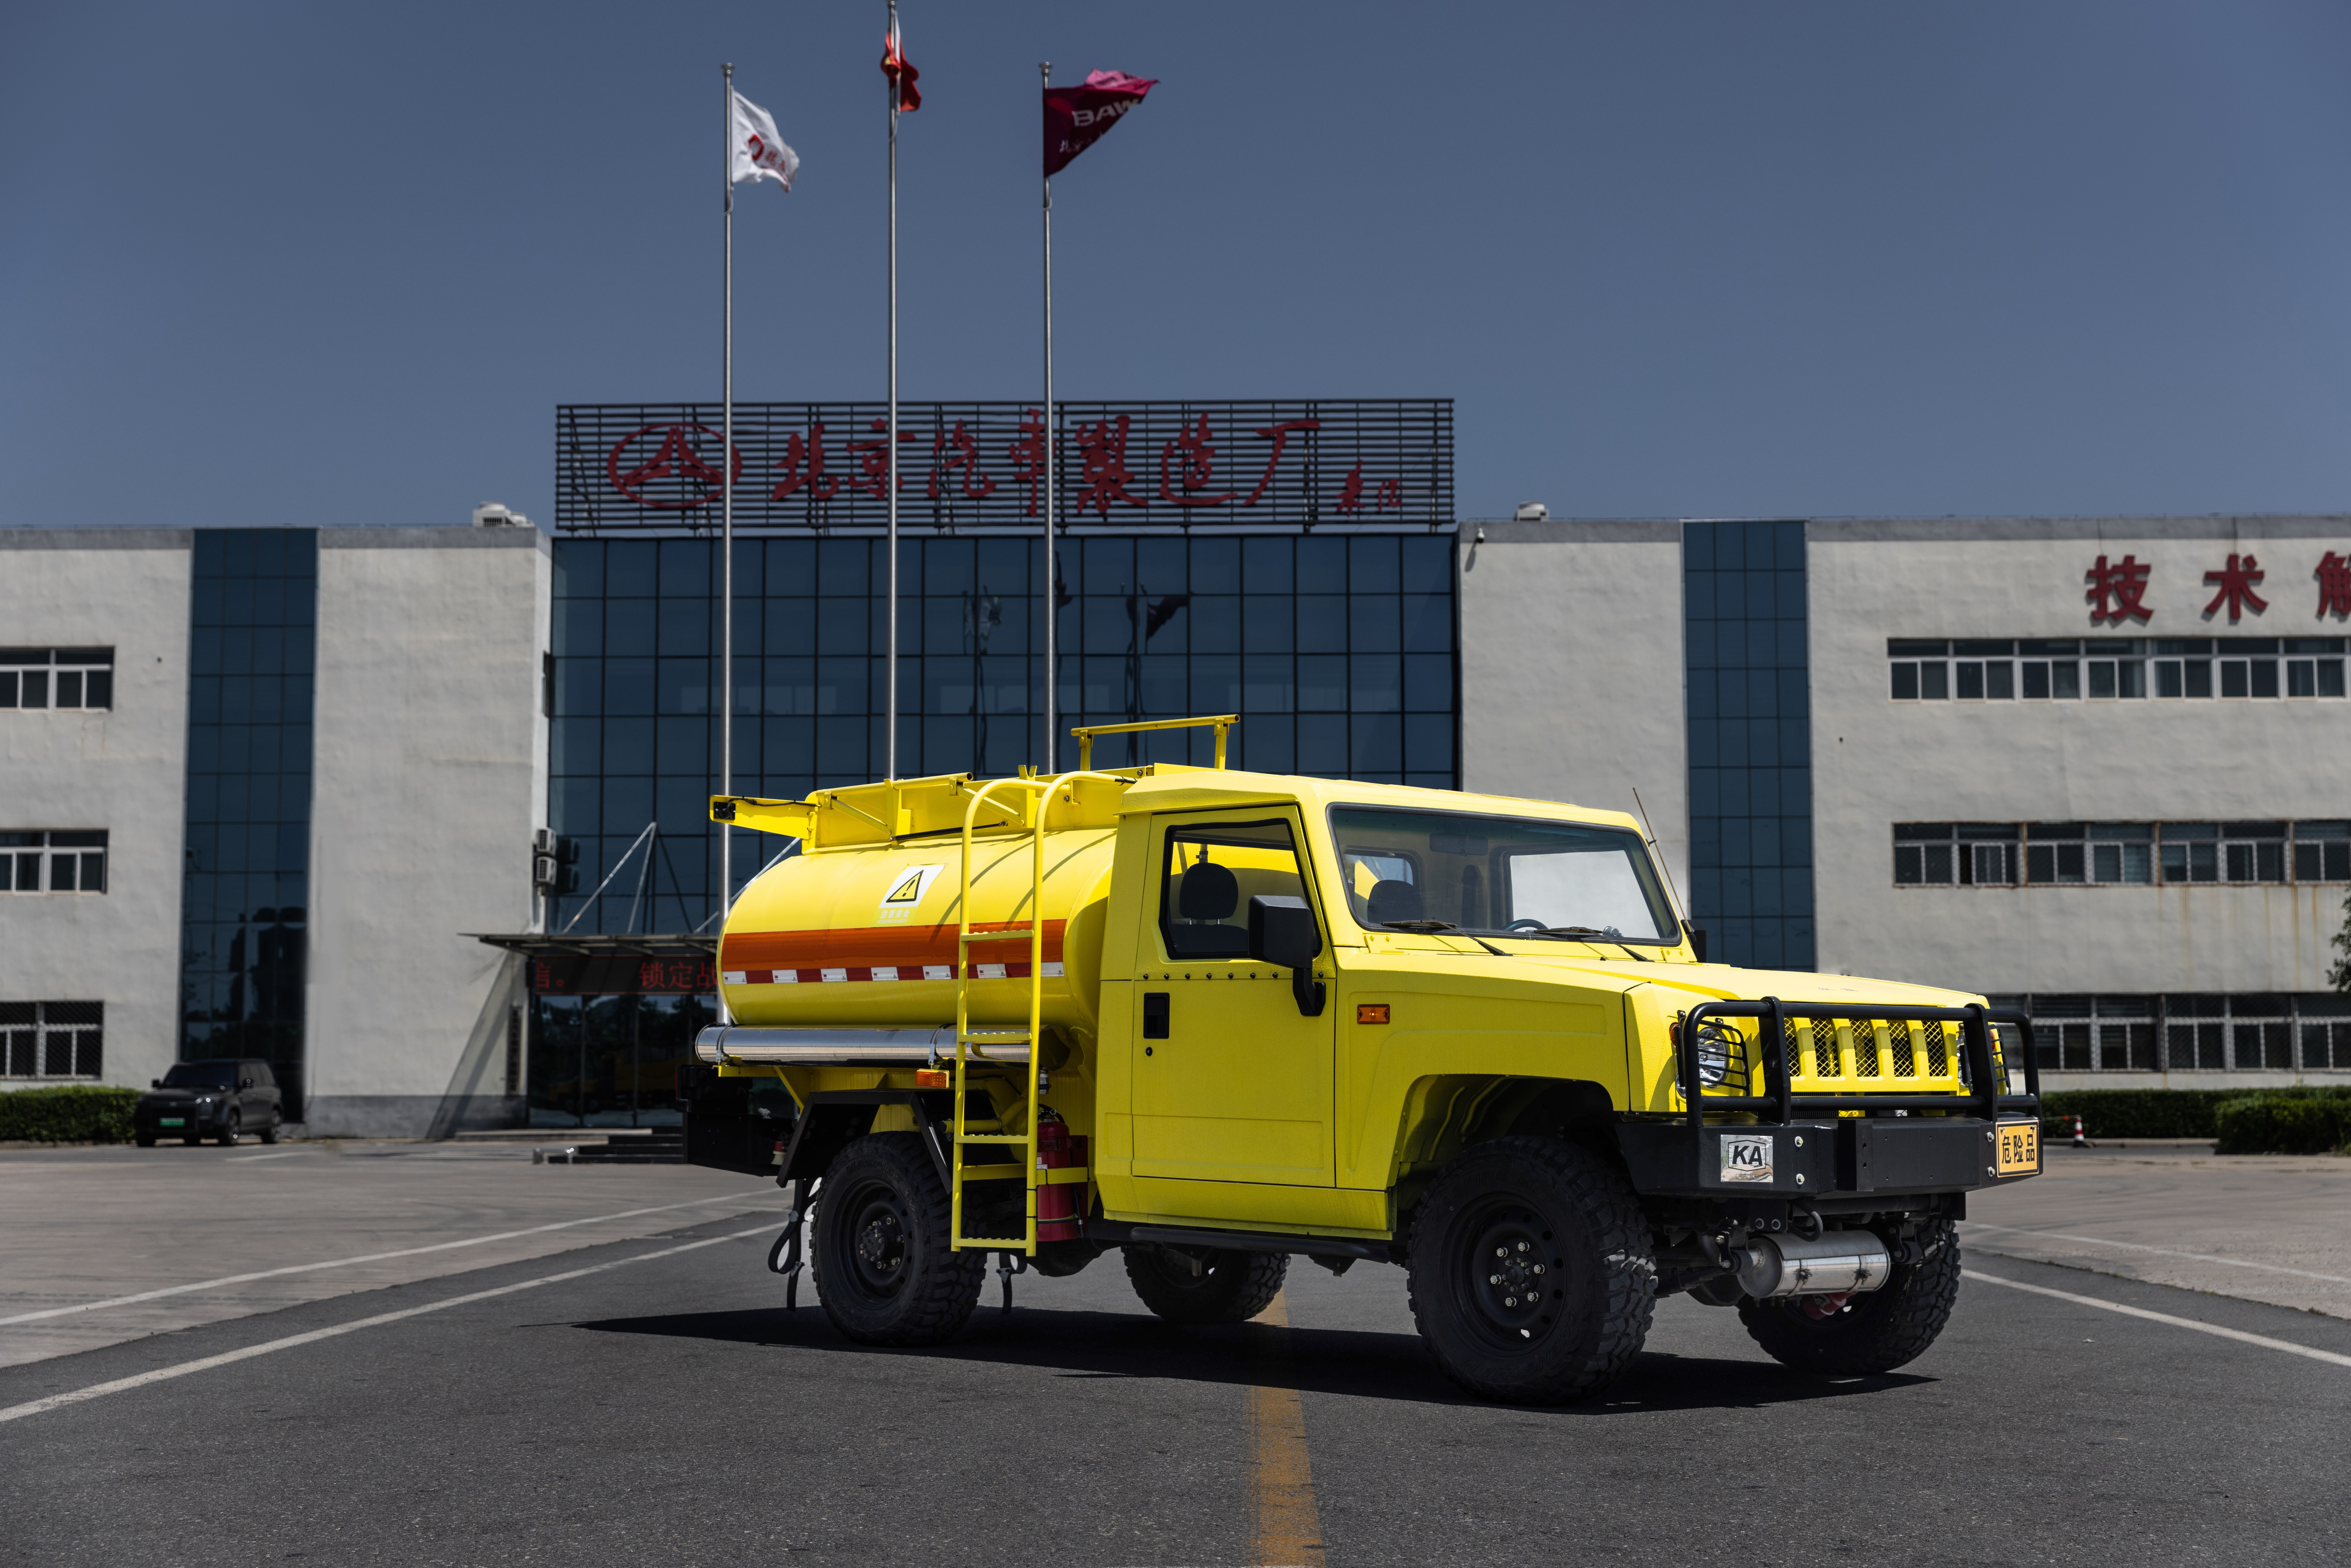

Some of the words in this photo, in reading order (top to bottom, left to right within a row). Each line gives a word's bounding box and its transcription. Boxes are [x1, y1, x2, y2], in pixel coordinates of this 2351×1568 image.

[880, 909, 910, 918] 注意安全
[638, 961, 717, 989] 锁定战
[1732, 1145, 1763, 1165] KA
[2002, 1134, 2035, 1164] 危险品
